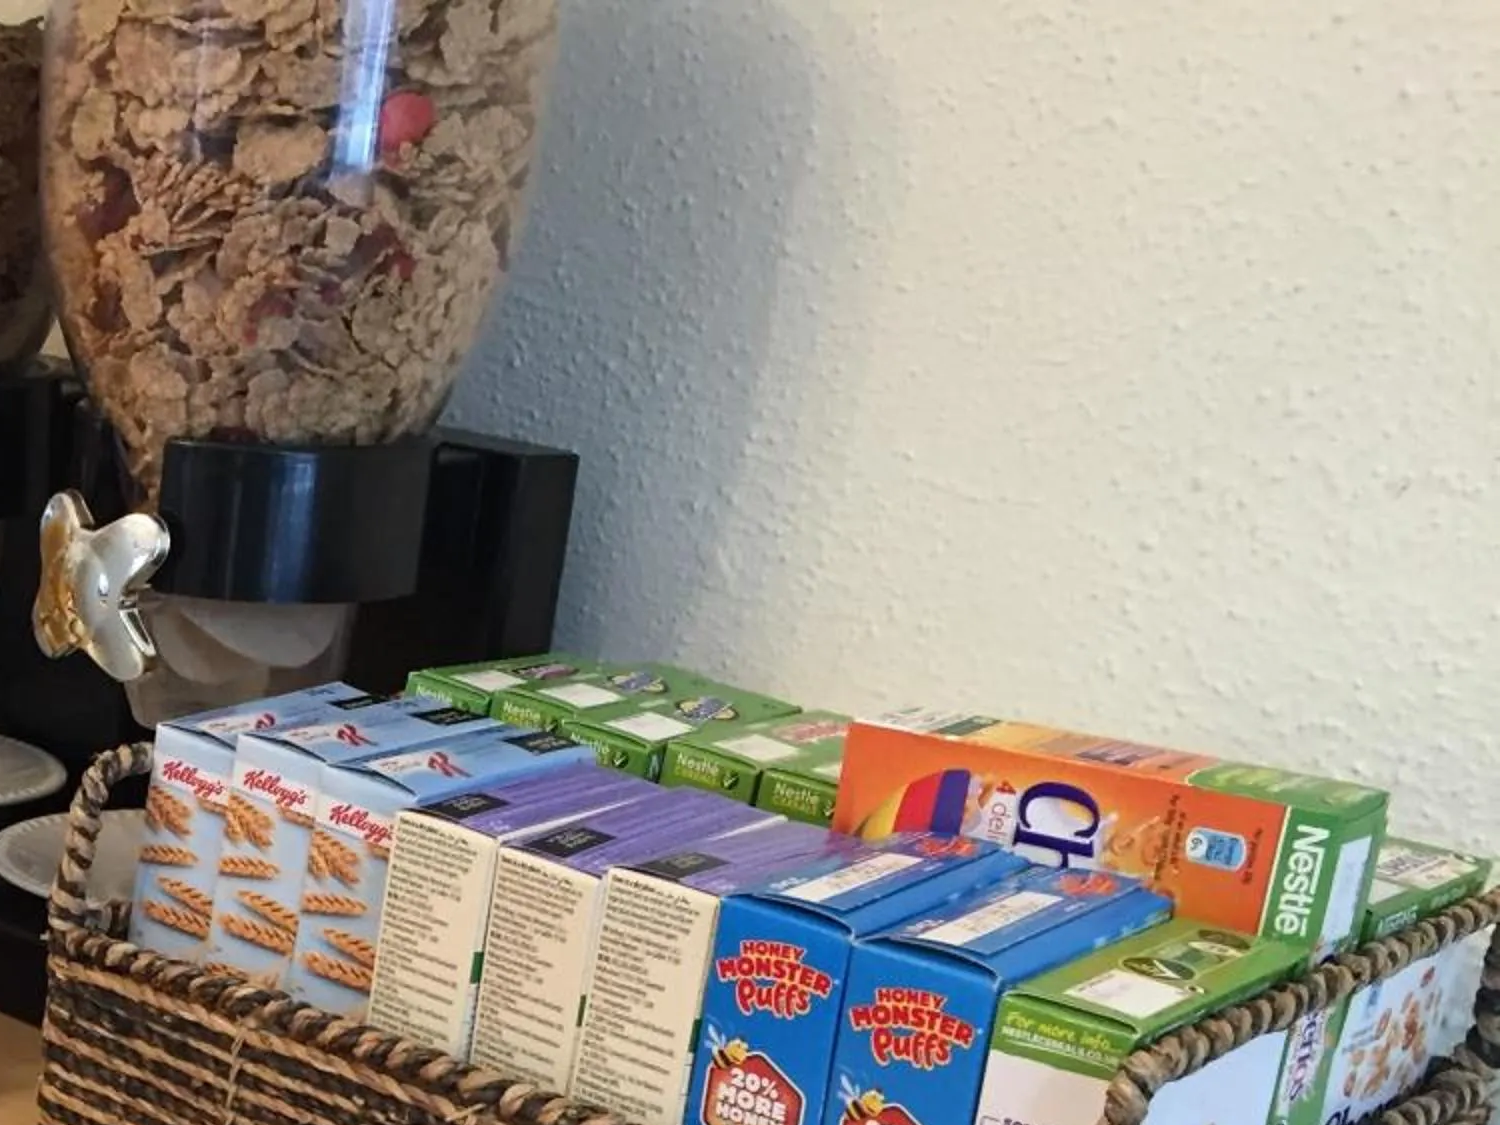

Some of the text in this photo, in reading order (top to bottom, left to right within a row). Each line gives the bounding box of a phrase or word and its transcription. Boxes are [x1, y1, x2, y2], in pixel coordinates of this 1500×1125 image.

[162, 759, 225, 798] Kellogg's
[243, 769, 309, 807] Kellogg's
[741, 941, 806, 961] HONEY
[717, 957, 832, 996] MONSTER
[736, 978, 810, 1018] Puffs
[876, 988, 947, 1009] HONEY
[850, 1004, 974, 1048] MONSTER
[872, 1027, 951, 1070] Puffs
[717, 1082, 787, 1122] MORE
[731, 1067, 779, 1100] 20%
